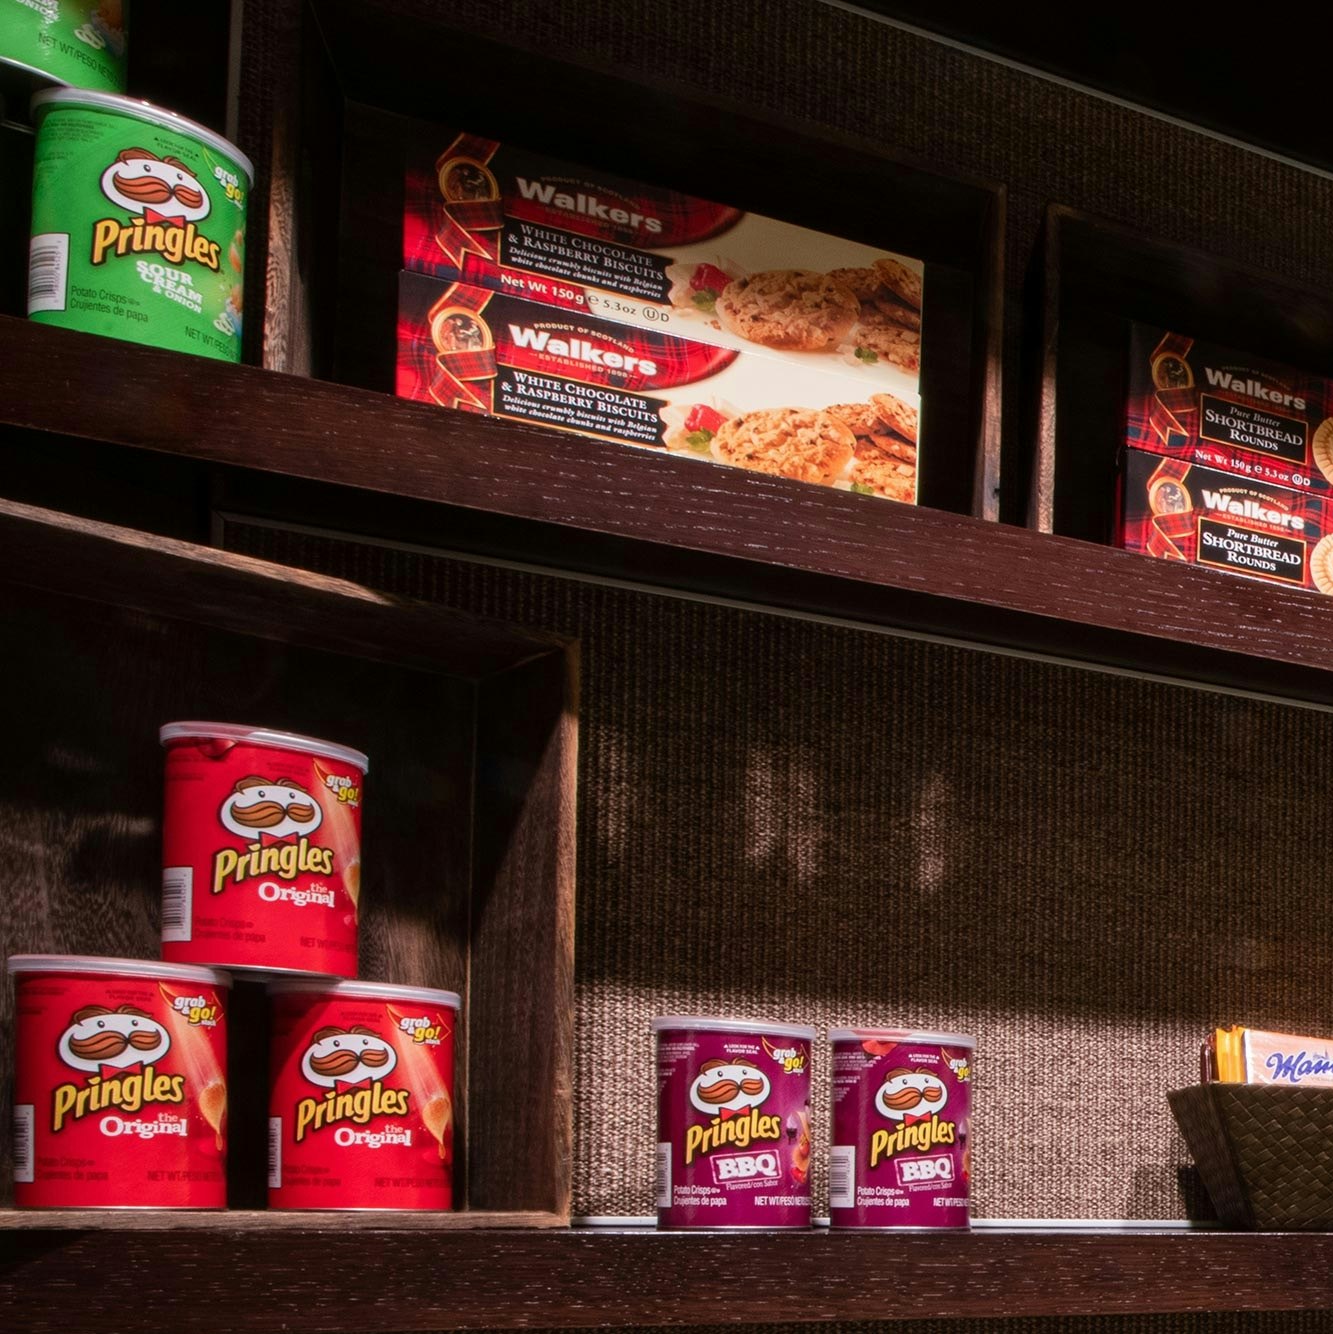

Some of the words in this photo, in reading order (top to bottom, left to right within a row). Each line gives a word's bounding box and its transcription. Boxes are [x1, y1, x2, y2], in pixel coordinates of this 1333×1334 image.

[516, 176, 662, 233] Walkers
[92, 217, 220, 270] Pringles
[520, 224, 567, 244] WHITE
[571, 238, 653, 267] CHOCOLATE
[508, 234, 518, 244] &
[524, 236, 599, 264] RASPBERRY
[604, 257, 664, 280] BISCUITS
[137, 261, 193, 286] SOUR
[501, 274, 524, 288] Net
[528, 280, 547, 294] Wt
[602, 277, 617, 287] and
[72, 286, 97, 298] Potato
[100, 290, 127, 305] Crisps
[140, 271, 202, 304] CREAM
[71, 300, 110, 313] Crujientes
[113, 306, 124, 316] de
[127, 310, 148, 323] papa
[165, 292, 202, 313] ONION
[508, 324, 657, 376] Walkers
[591, 330, 635, 353] SCOTLAND
[513, 372, 561, 391] WHITE
[565, 384, 647, 409] CHOCOLATE
[1205, 368, 1306, 410] Walkers
[501, 382, 512, 392] &
[517, 383, 593, 409] RASPBERRY
[598, 402, 658, 423] BISCUITS
[1230, 407, 1250, 419] Pure
[503, 395, 540, 409] Delicious
[542, 403, 574, 416] crumbly
[608, 418, 625, 427] with
[628, 421, 657, 434] Belgian
[504, 404, 526, 414] white
[529, 409, 564, 422] chocolate
[567, 416, 593, 428] chunks
[595, 422, 611, 432] and
[1206, 409, 1302, 446] SHORTBREAD
[1230, 429, 1278, 451] ROUNDS
[1195, 450, 1211, 460] Net
[1215, 455, 1227, 465] Wt
[1202, 490, 1304, 530] Walkers
[1203, 532, 1301, 565] SHORTBREAD
[1227, 529, 1248, 541] Pure
[1251, 534, 1278, 548] Butter
[1227, 551, 1276, 571] ROUNDS
[326, 775, 351, 787] grab
[339, 787, 358, 801] go!
[212, 837, 334, 894] Pringles
[258, 882, 335, 907] Original
[310, 882, 327, 893] the
[174, 996, 205, 1009] grab
[189, 1007, 215, 1022] go!
[400, 1017, 431, 1029] grab
[415, 1027, 439, 1042] go!
[773, 1049, 796, 1060] grab
[784, 1057, 803, 1071] go!
[950, 1058, 967, 1069] grab
[53, 1067, 184, 1132] Pringles
[159, 1113, 177, 1122] the
[297, 1081, 409, 1141] Pringles
[100, 1116, 188, 1138] Original
[335, 1128, 411, 1148] Original
[385, 1125, 402, 1133] the
[686, 1109, 780, 1164] Pringles
[871, 1115, 954, 1167] Pringles
[717, 1154, 777, 1179] BBQ
[901, 1158, 951, 1181] BBQ
[691, 1185, 711, 1194] Crisps
[876, 1187, 894, 1196] Crisps
[711, 1198, 726, 1206] papa
[755, 1197, 767, 1205] NET
[886, 1197, 893, 1205] de
[894, 1198, 909, 1206] papa
